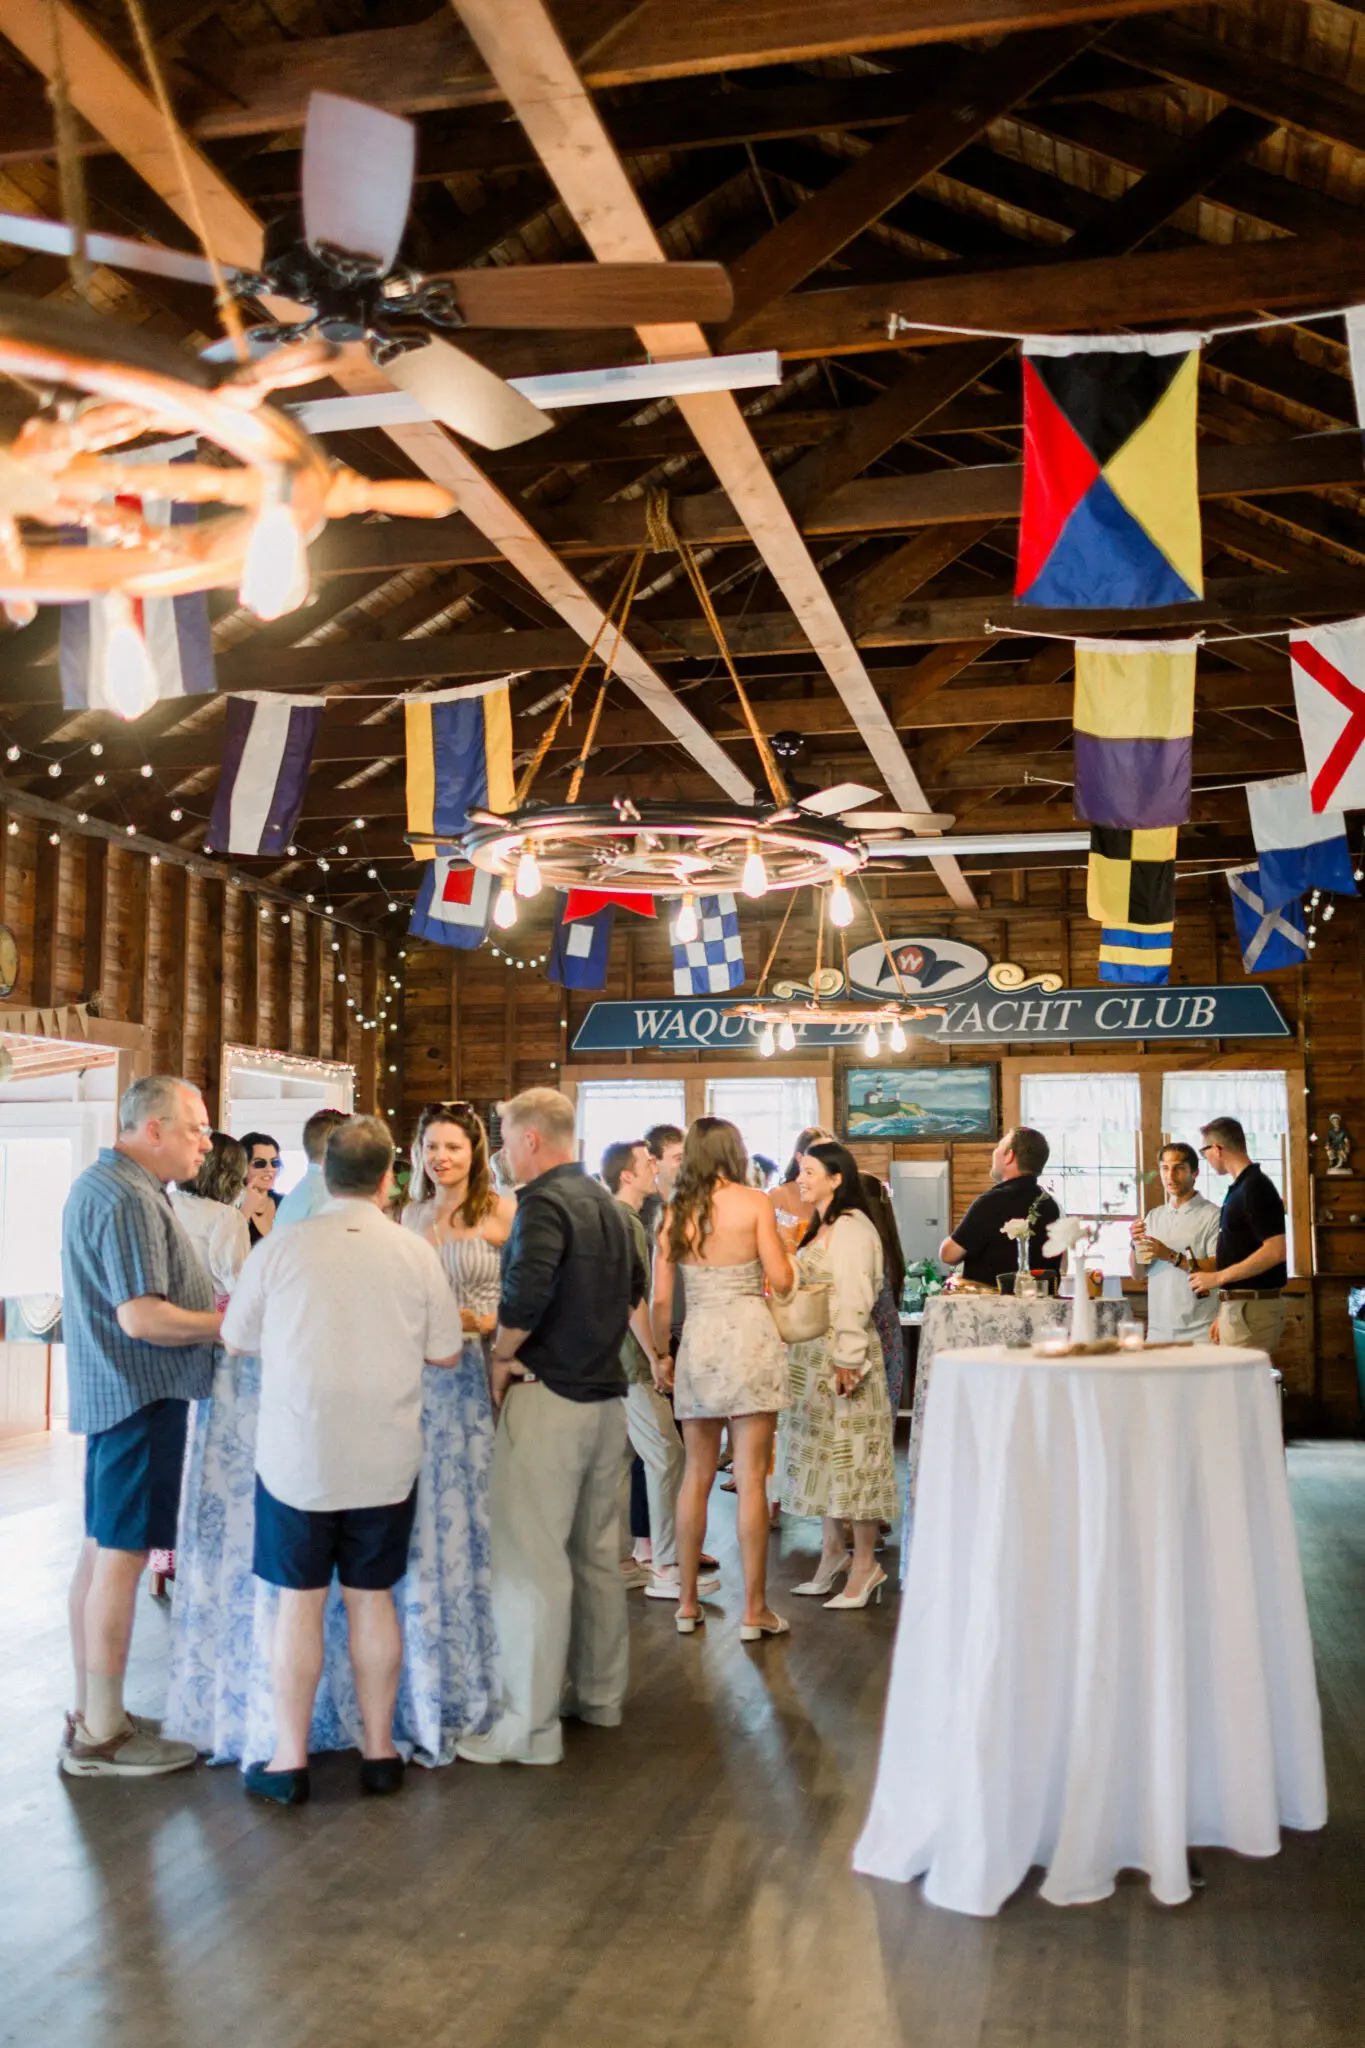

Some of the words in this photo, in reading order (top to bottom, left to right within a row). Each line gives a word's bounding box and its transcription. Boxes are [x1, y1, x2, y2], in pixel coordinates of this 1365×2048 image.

[898, 953, 923, 971] W
[633, 1007, 808, 1045] WAQU
[934, 999, 1082, 1034] YACHT
[1094, 995, 1218, 1030] CLUB
